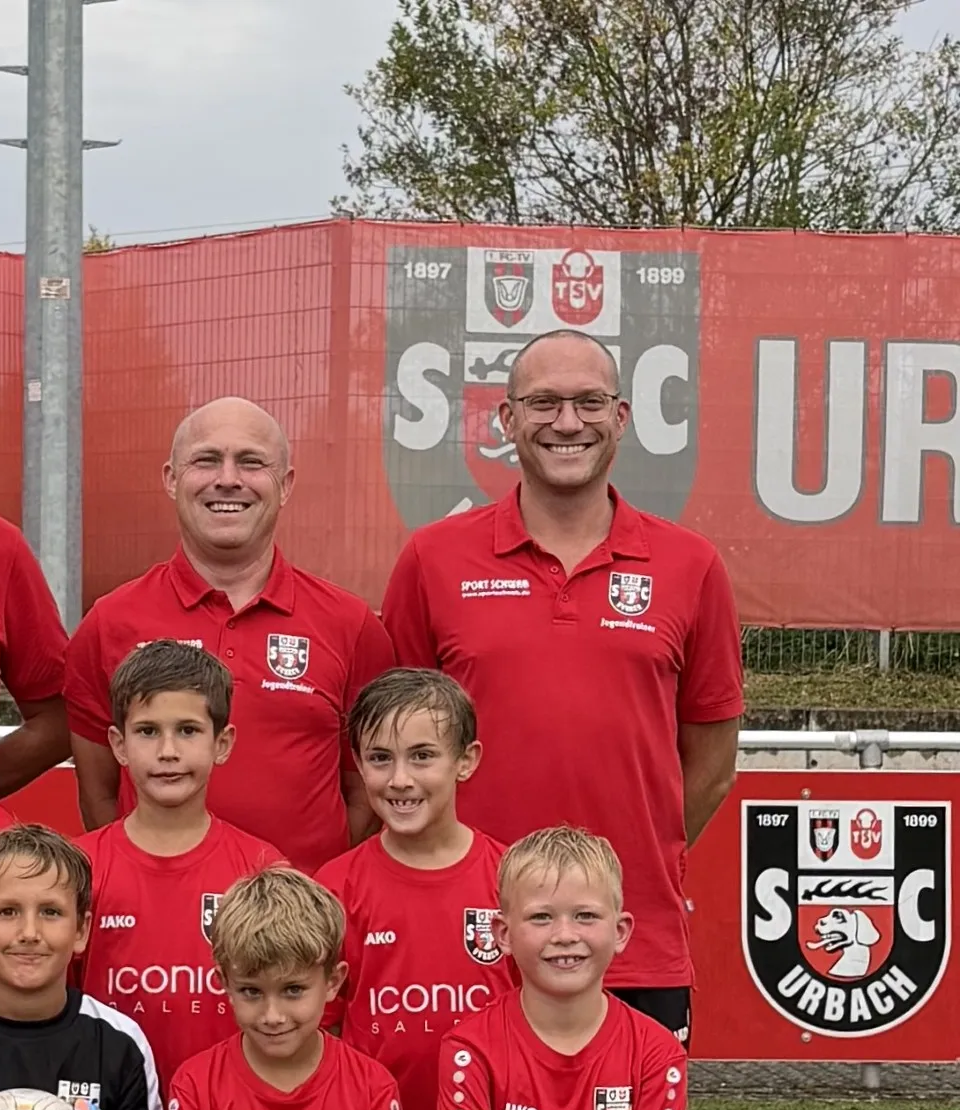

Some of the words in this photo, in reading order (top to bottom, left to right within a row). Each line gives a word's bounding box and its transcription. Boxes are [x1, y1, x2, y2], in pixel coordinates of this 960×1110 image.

[403, 261, 452, 279] 1897
[636, 267, 685, 284] 1899
[555, 281, 602, 301] TSV
[393, 341, 451, 450] S
[632, 345, 689, 454] C
[756, 339, 960, 522] UR
[756, 813, 789, 827] 1897
[902, 814, 937, 828] 1899
[852, 830, 881, 844] TSV
[754, 867, 792, 941] S
[898, 868, 935, 942] C
[99, 914, 136, 928] JAKO
[364, 930, 396, 945] AKO
[777, 965, 918, 1023] URBACH
